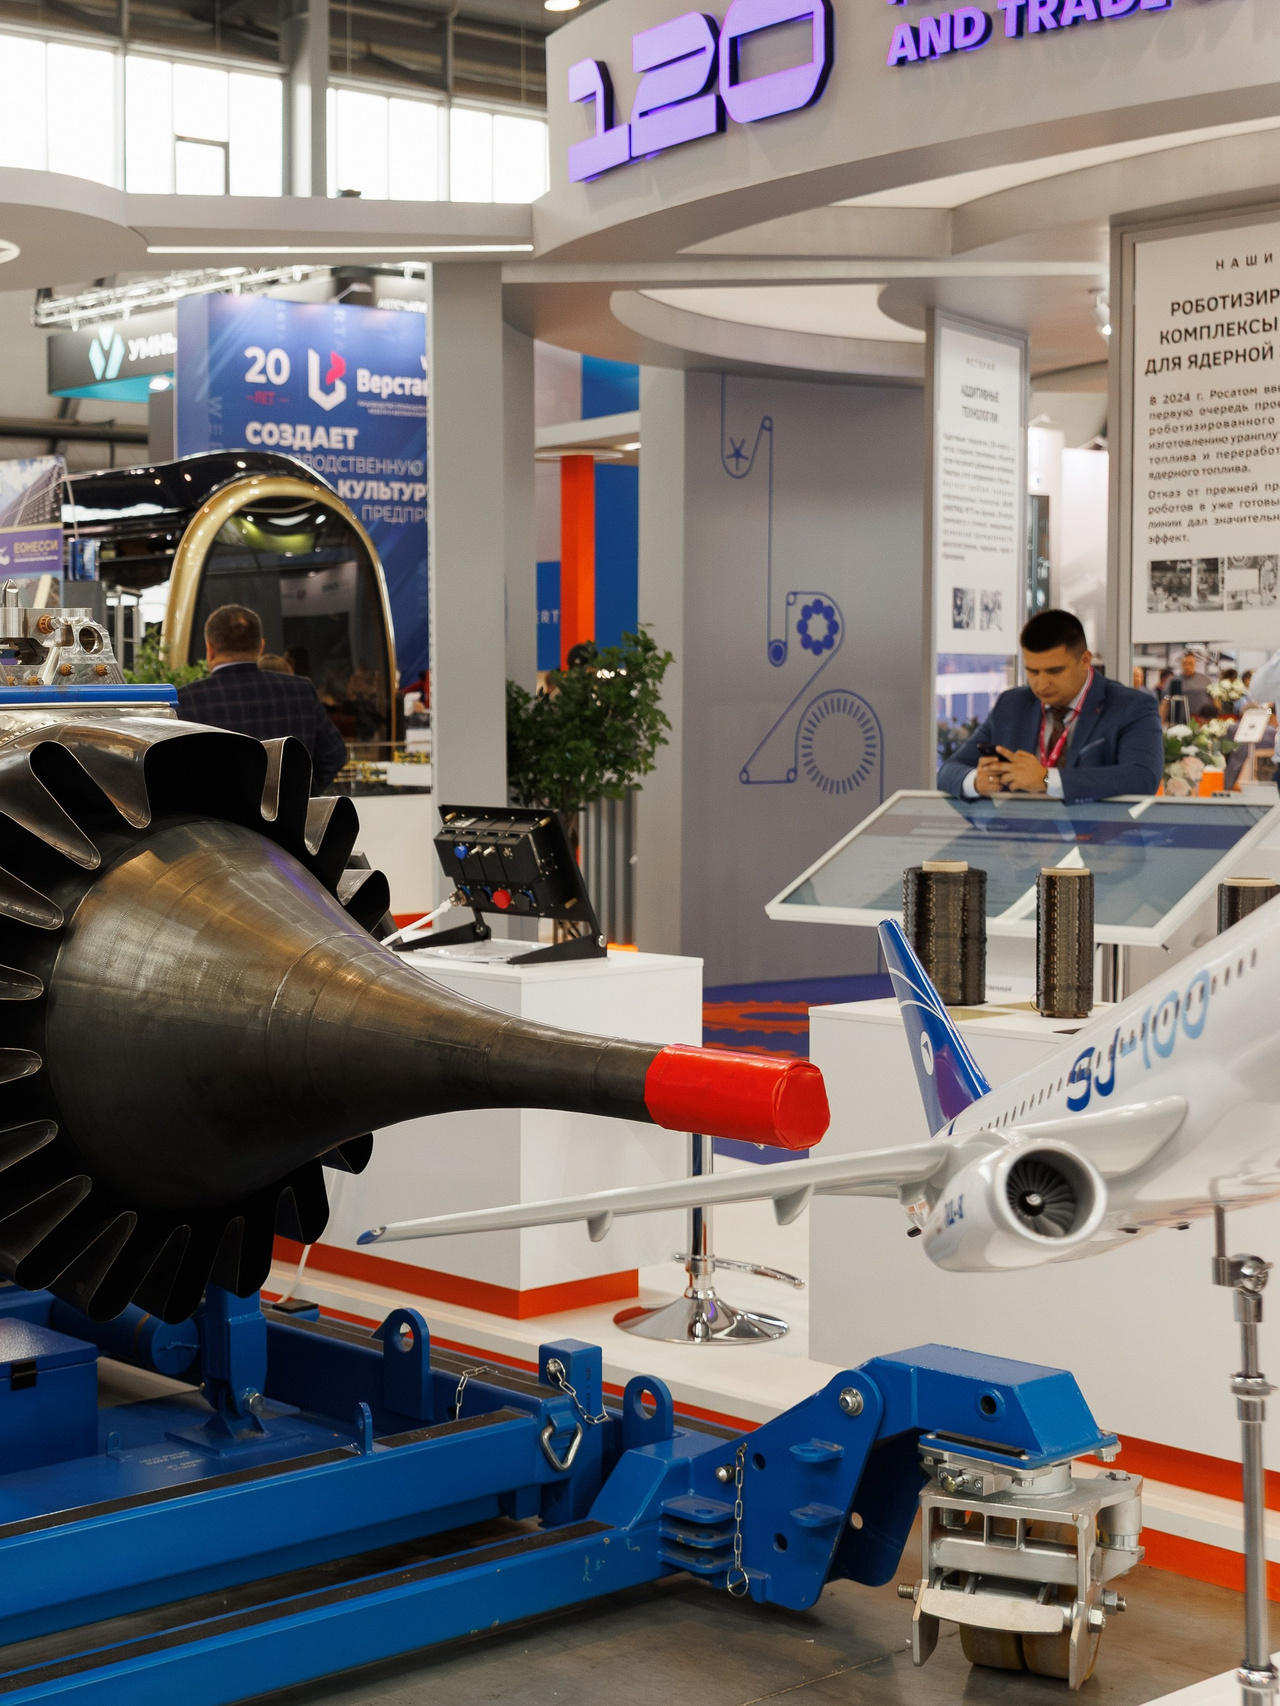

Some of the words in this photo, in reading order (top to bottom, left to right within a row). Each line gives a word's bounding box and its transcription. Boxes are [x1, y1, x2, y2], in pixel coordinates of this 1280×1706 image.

[886, 6, 987, 66] AND
[997, 0, 1172, 37] TRA
[568, 0, 830, 184] 120
[1215, 252, 1273, 271] НАШИ
[1159, 316, 1278, 346] КОМПЛЕКСЫ
[244, 345, 290, 386] 20
[1144, 355, 1182, 377] ДЛЯ
[1187, 341, 1274, 370] ЯДЕРНОЙ
[1162, 392, 1191, 405] 2024
[1209, 385, 1258, 400] Росатом
[1149, 408, 1193, 421] первую
[1199, 403, 1248, 417] очередь
[245, 421, 359, 451] СОЗДАЕТ
[1149, 415, 1276, 437] роботизированного
[1149, 435, 1229, 450] изготовлению
[1149, 453, 1197, 466] топлива
[1148, 468, 1200, 482] ядерного
[1202, 464, 1251, 477] топлива.
[1148, 488, 1181, 501] Отказ
[1187, 487, 1199, 498] от
[1205, 482, 1258, 498] прежней
[361, 503, 427, 525] ПРЕДПР
[1148, 502, 1193, 516] роботов
[1211, 500, 1233, 513] уже
[1148, 520, 1182, 530] линии
[1187, 517, 1208, 528] дал
[1148, 533, 1190, 547] эффект.
[1066, 969, 1210, 1112] SJ-100
